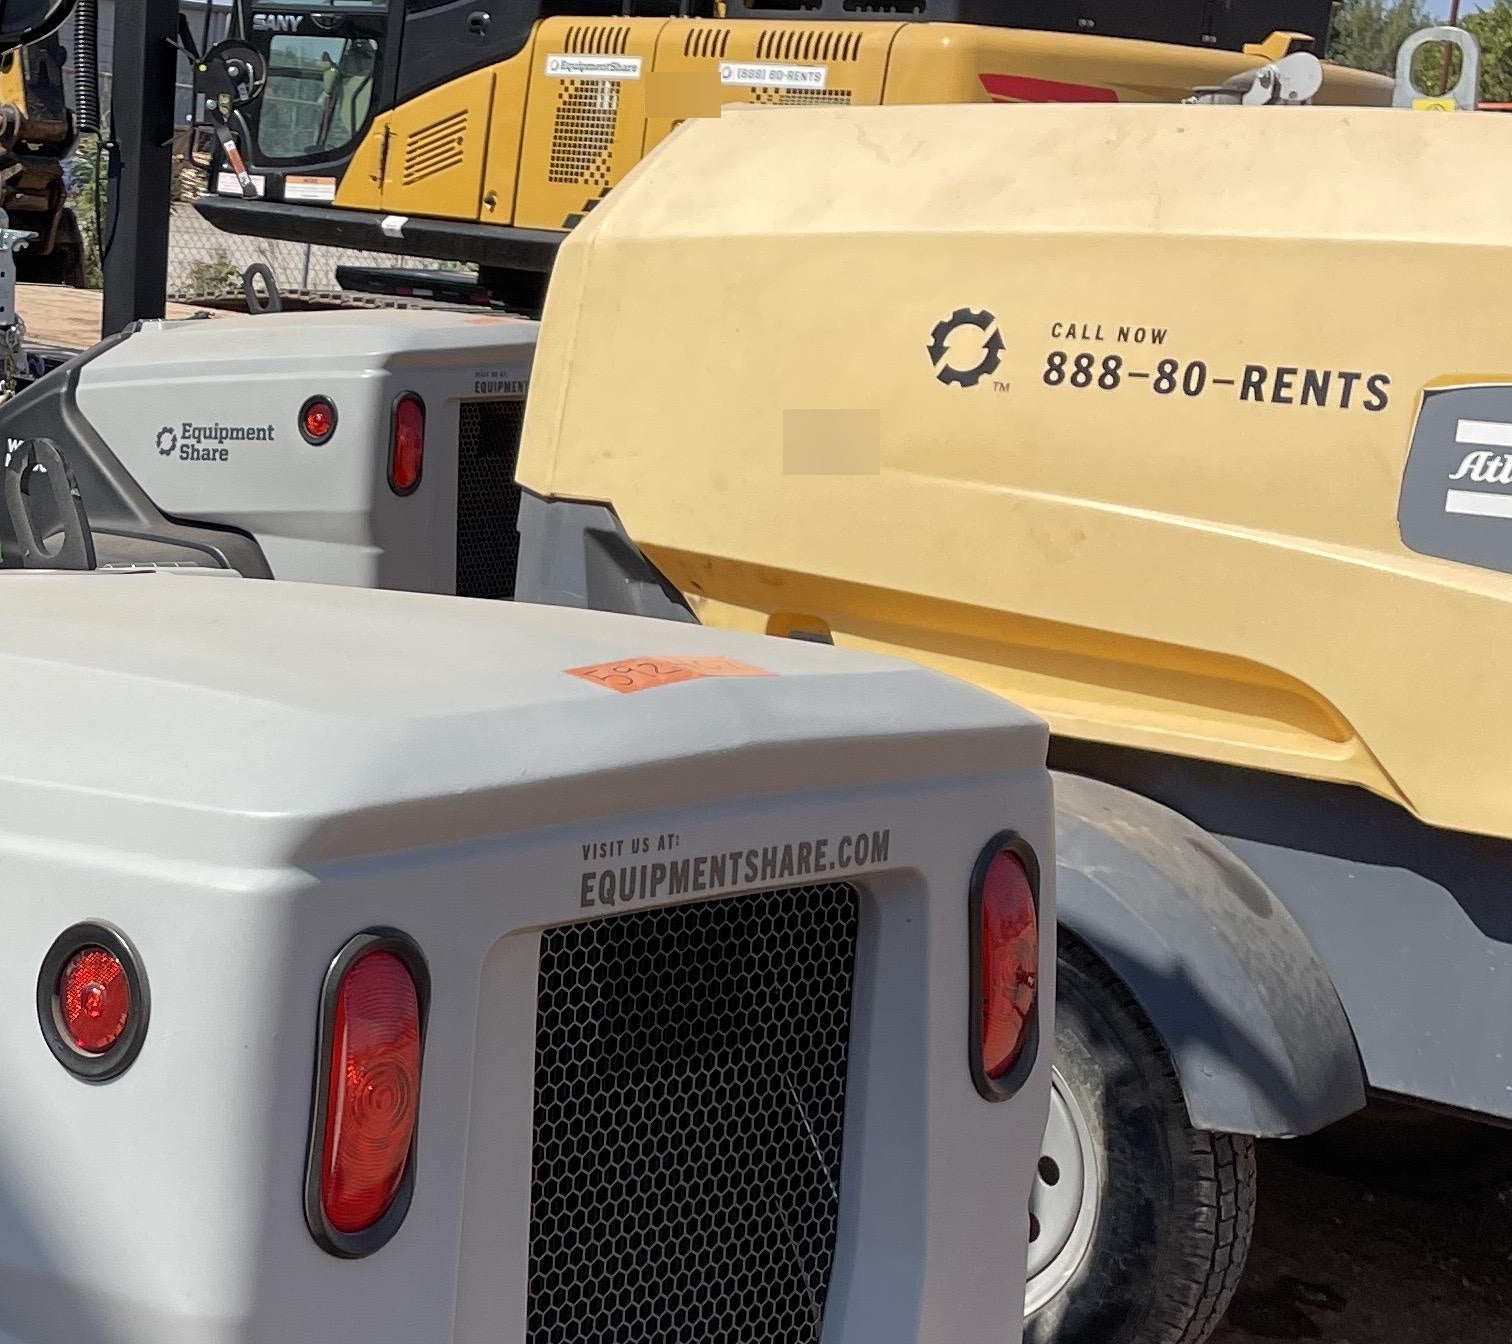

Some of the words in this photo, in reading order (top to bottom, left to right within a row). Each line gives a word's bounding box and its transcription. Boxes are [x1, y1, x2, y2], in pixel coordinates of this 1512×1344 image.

[252, 13, 303, 32] SANY
[1051, 322, 1105, 341] CALL
[1117, 326, 1168, 345] NOW
[1042, 350, 1391, 412] 888-80-RENTS
[180, 422, 275, 444] Equipment
[179, 444, 229, 462] Share
[582, 840, 624, 861] VISIT
[631, 836, 650, 854] US
[658, 833, 679, 850] AT:
[580, 829, 890, 908] EQUIPMENTSHARE.COM
